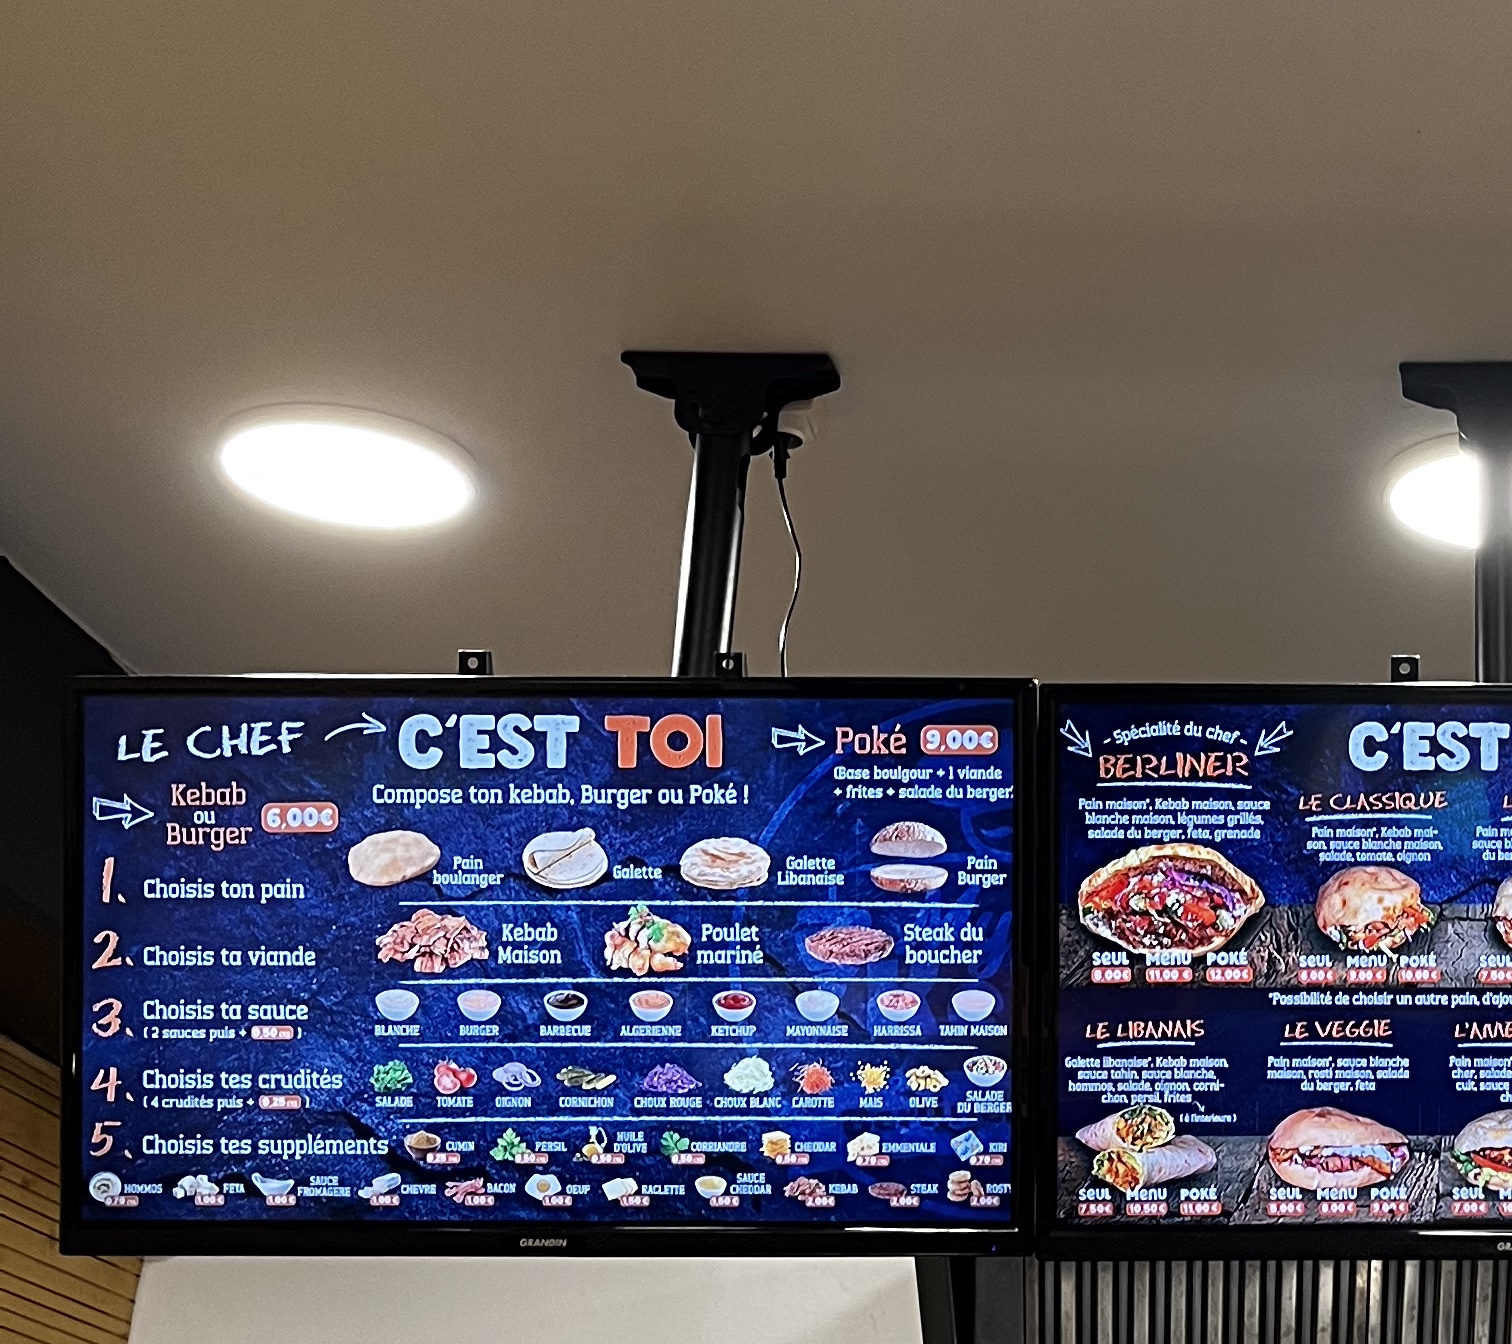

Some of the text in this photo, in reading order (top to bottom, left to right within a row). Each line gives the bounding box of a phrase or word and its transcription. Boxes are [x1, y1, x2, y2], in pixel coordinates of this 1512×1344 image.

[118, 721, 304, 762] LE CHEF
[605, 714, 722, 768] TOI
[836, 724, 994, 754] Poké 9,00€
[1184, 721, 1202, 737] du
[1206, 725, 1241, 744] chef
[874, 765, 933, 783] boulgour
[957, 766, 1002, 779] viande
[1100, 752, 1248, 778] BERLINER
[171, 781, 246, 805] Kebab
[373, 783, 737, 809] Compose ton kebab, Burger ou Poké
[846, 784, 963, 798] frites salade du
[1299, 791, 1447, 811] LE CLASSIQUE
[194, 811, 215, 824] ou
[266, 806, 334, 829] 6,00€
[167, 822, 252, 851] Burger
[453, 855, 483, 871] Pain
[786, 855, 835, 872] Galette
[967, 855, 997, 869] Pain
[431, 867, 504, 888] boulanger
[613, 864, 662, 880] Galette
[777, 869, 844, 885] Libanaise
[958, 871, 1007, 888] Burger
[144, 878, 214, 898] Choisis
[221, 881, 254, 898] ton
[261, 878, 305, 904] pain
[502, 922, 557, 941] Kebab
[702, 923, 759, 941] Poulet
[904, 923, 983, 941] Steak du
[144, 945, 214, 965] Choisis
[221, 948, 242, 965] ta
[248, 945, 315, 966] viande
[498, 945, 562, 964] Maison
[696, 945, 763, 964] mariné
[905, 945, 982, 964] boucher
[1335, 991, 1350, 1005] de
[1352, 991, 1393, 1005] choisir
[1396, 995, 1412, 1005] un
[1415, 993, 1448, 1005] autre
[143, 1000, 214, 1019] Choisis
[220, 1001, 241, 1019] ta
[248, 1005, 308, 1020] sauce
[375, 1025, 420, 1036] BLANCHE
[460, 1025, 499, 1036] BURGER
[540, 1025, 591, 1036] BARBECUE
[711, 1025, 756, 1036] KETCHUP
[786, 1025, 848, 1036] MAYONNAISE
[970, 1025, 1007, 1036] MAISON
[1086, 1020, 1204, 1039] LE LIBANAIS
[1285, 1019, 1392, 1039] LE VEGGIE
[143, 1069, 213, 1088] Choisis
[220, 1072, 252, 1089] tes
[258, 1068, 342, 1091] crudités
[376, 1096, 413, 1107] SALADE
[436, 1096, 473, 1107] TOMATE
[495, 1097, 531, 1107] OIGNON
[559, 1097, 614, 1107] CORNICHON
[634, 1097, 702, 1108] CHOUX ROUGE
[714, 1097, 781, 1108] CHOUX BLANC
[792, 1097, 834, 1108] CAROTTE
[909, 1097, 938, 1108] OLIVE
[143, 1134, 213, 1154] Choisis
[220, 1137, 251, 1154] tes
[258, 1133, 389, 1161] suppléments
